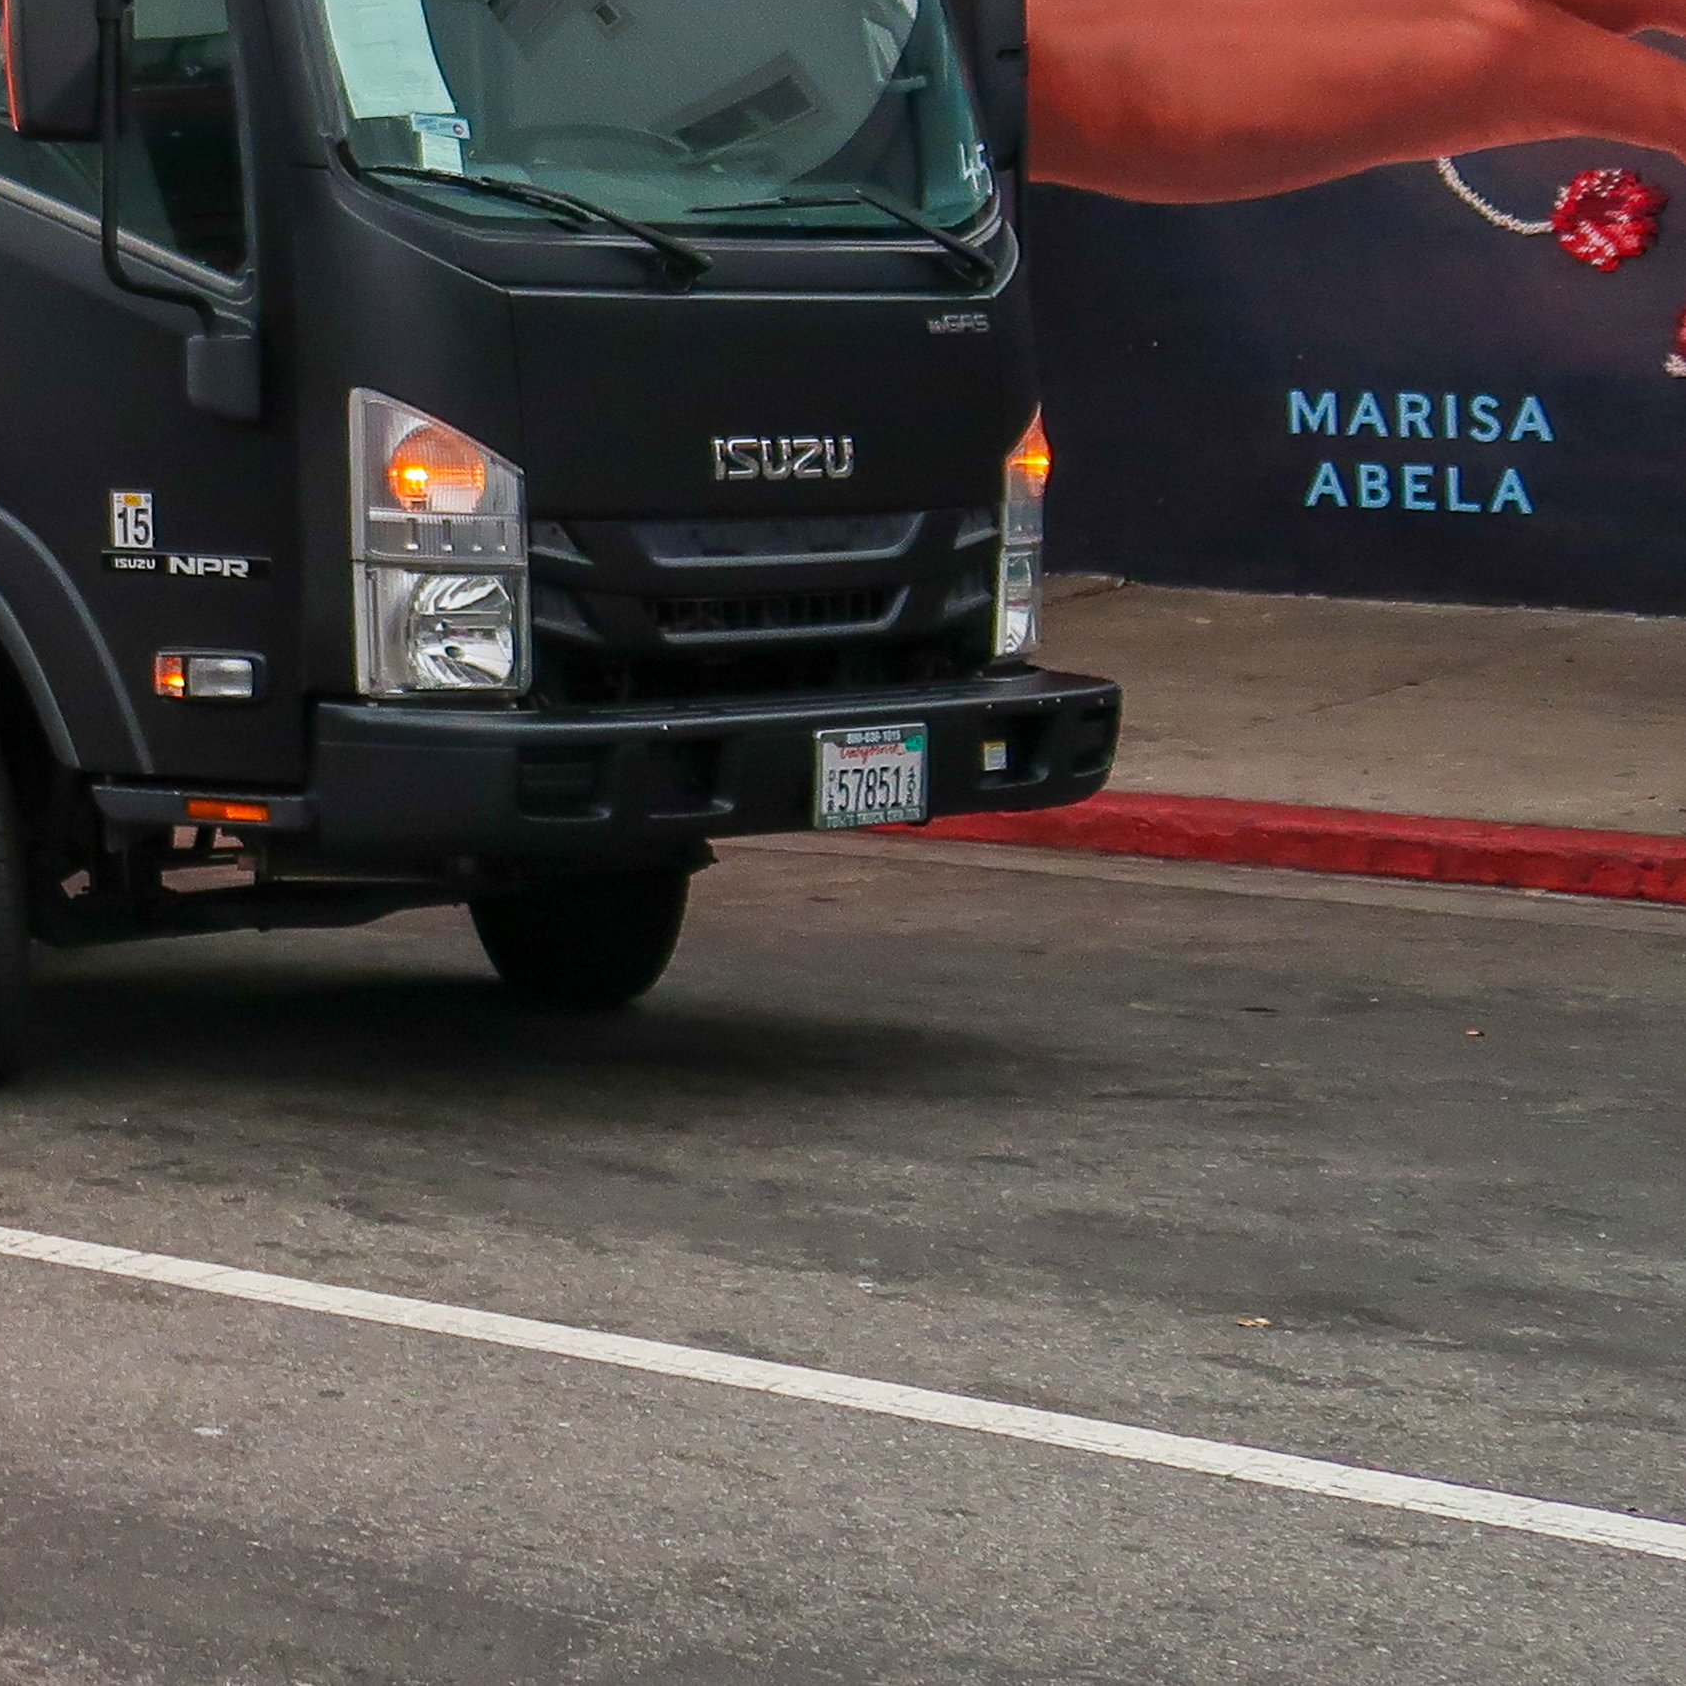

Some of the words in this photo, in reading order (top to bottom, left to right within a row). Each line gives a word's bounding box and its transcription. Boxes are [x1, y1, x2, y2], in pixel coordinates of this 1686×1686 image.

[1286, 388, 1556, 444] MARISA
[711, 434, 856, 482] ISUZU
[1305, 461, 1535, 517] ABELA
[117, 506, 151, 546] 15
[114, 557, 156, 570] ISUZU
[168, 555, 250, 579] NPR
[837, 765, 903, 813] 57851
